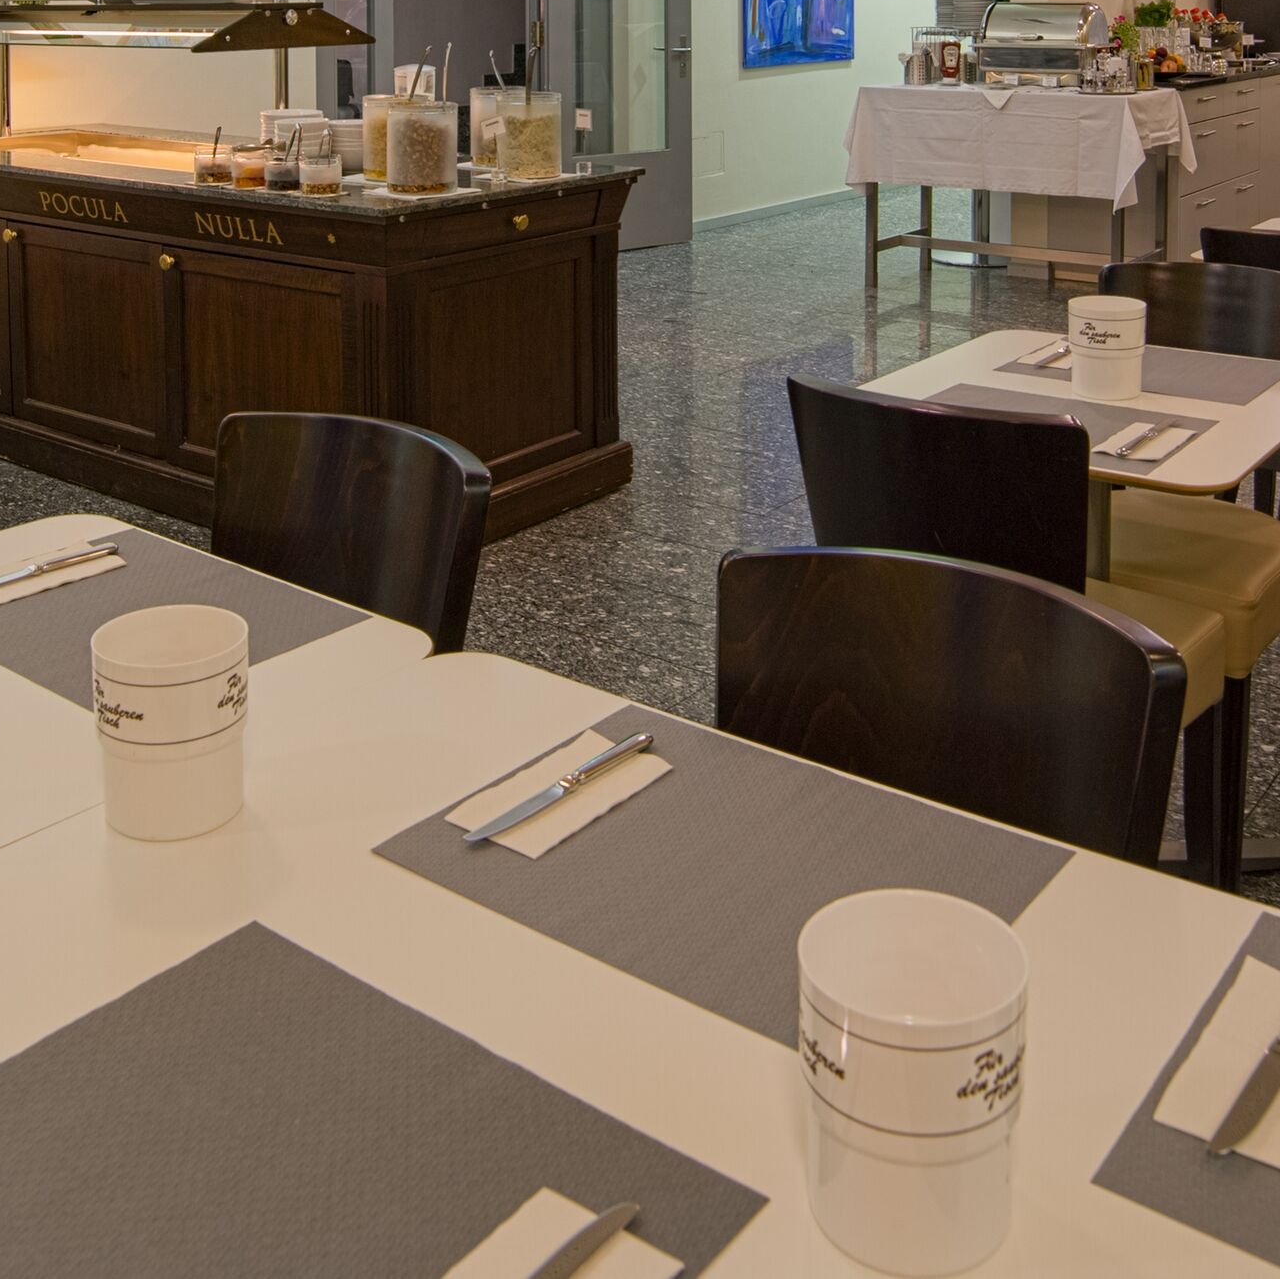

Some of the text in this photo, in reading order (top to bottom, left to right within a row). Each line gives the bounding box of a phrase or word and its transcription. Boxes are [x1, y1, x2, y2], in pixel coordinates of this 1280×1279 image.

[39, 191, 129, 223] POCULA
[194, 211, 284, 246] NULLA
[99, 701, 144, 721] sauberen
[217, 693, 234, 709] den
[974, 1048, 1003, 1079] Für
[956, 1076, 988, 1100] den
